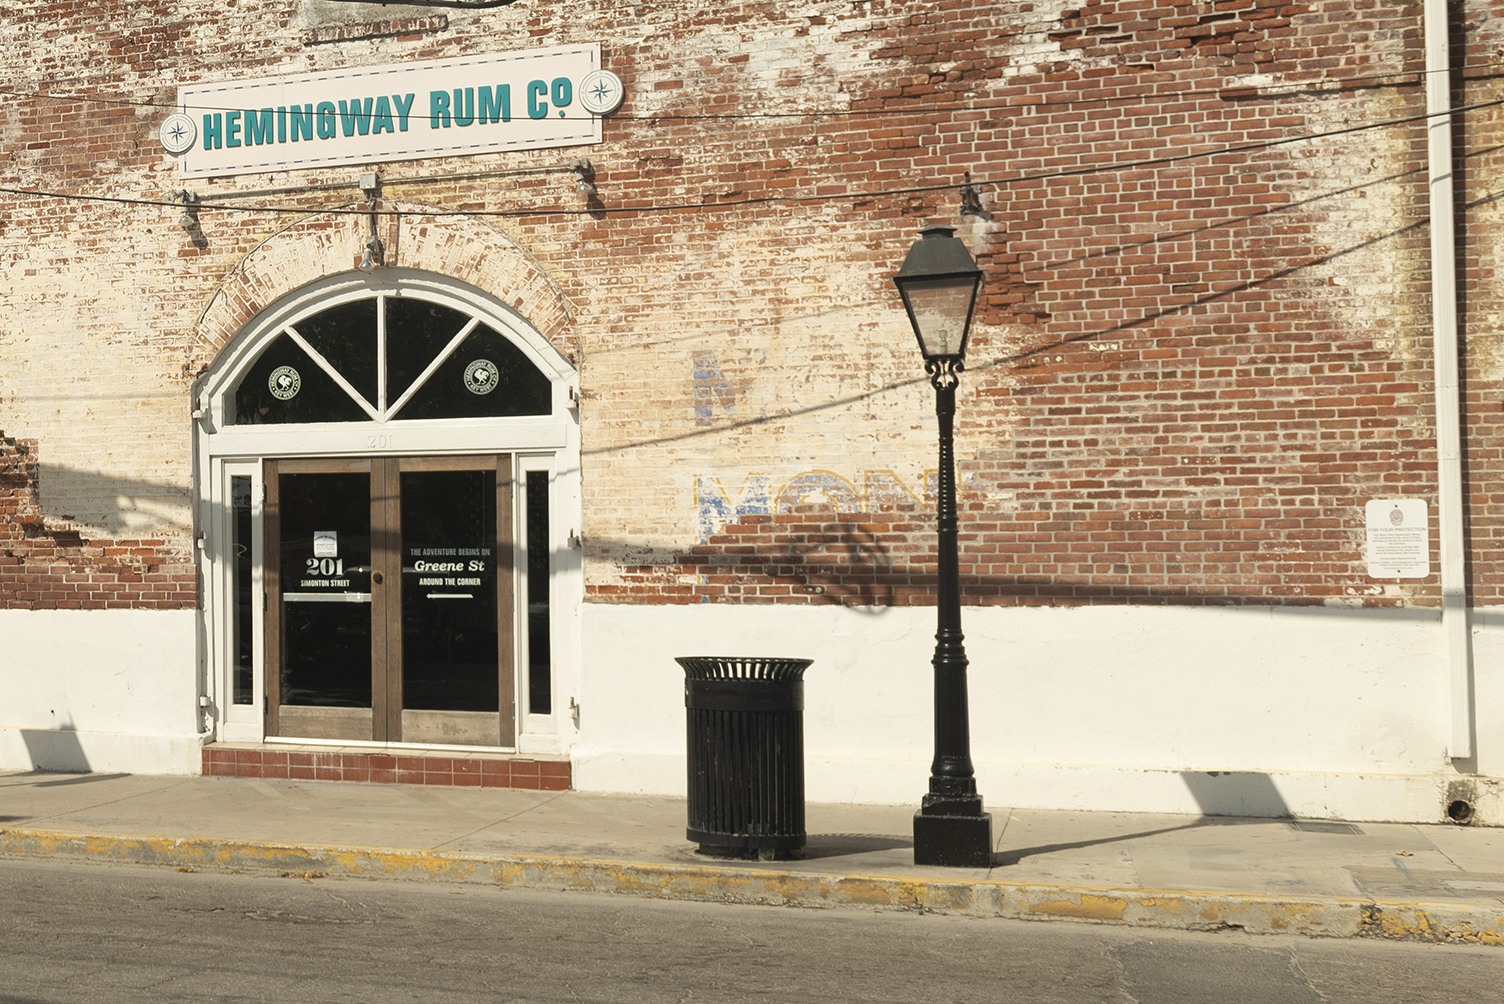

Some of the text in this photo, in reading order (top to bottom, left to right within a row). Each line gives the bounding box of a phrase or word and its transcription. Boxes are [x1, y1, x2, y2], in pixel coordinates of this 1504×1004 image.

[202, 93, 415, 150] HEMINGWAY
[429, 83, 511, 130] RUM
[366, 434, 393, 449] 201
[410, 548, 491, 556] THE ADVENTURE BEGINS ON
[306, 558, 344, 576] 201
[414, 560, 485, 572] Greene St
[300, 579, 350, 587] SIMONTON STREET
[419, 577, 481, 586] AROUND THE CORNER
